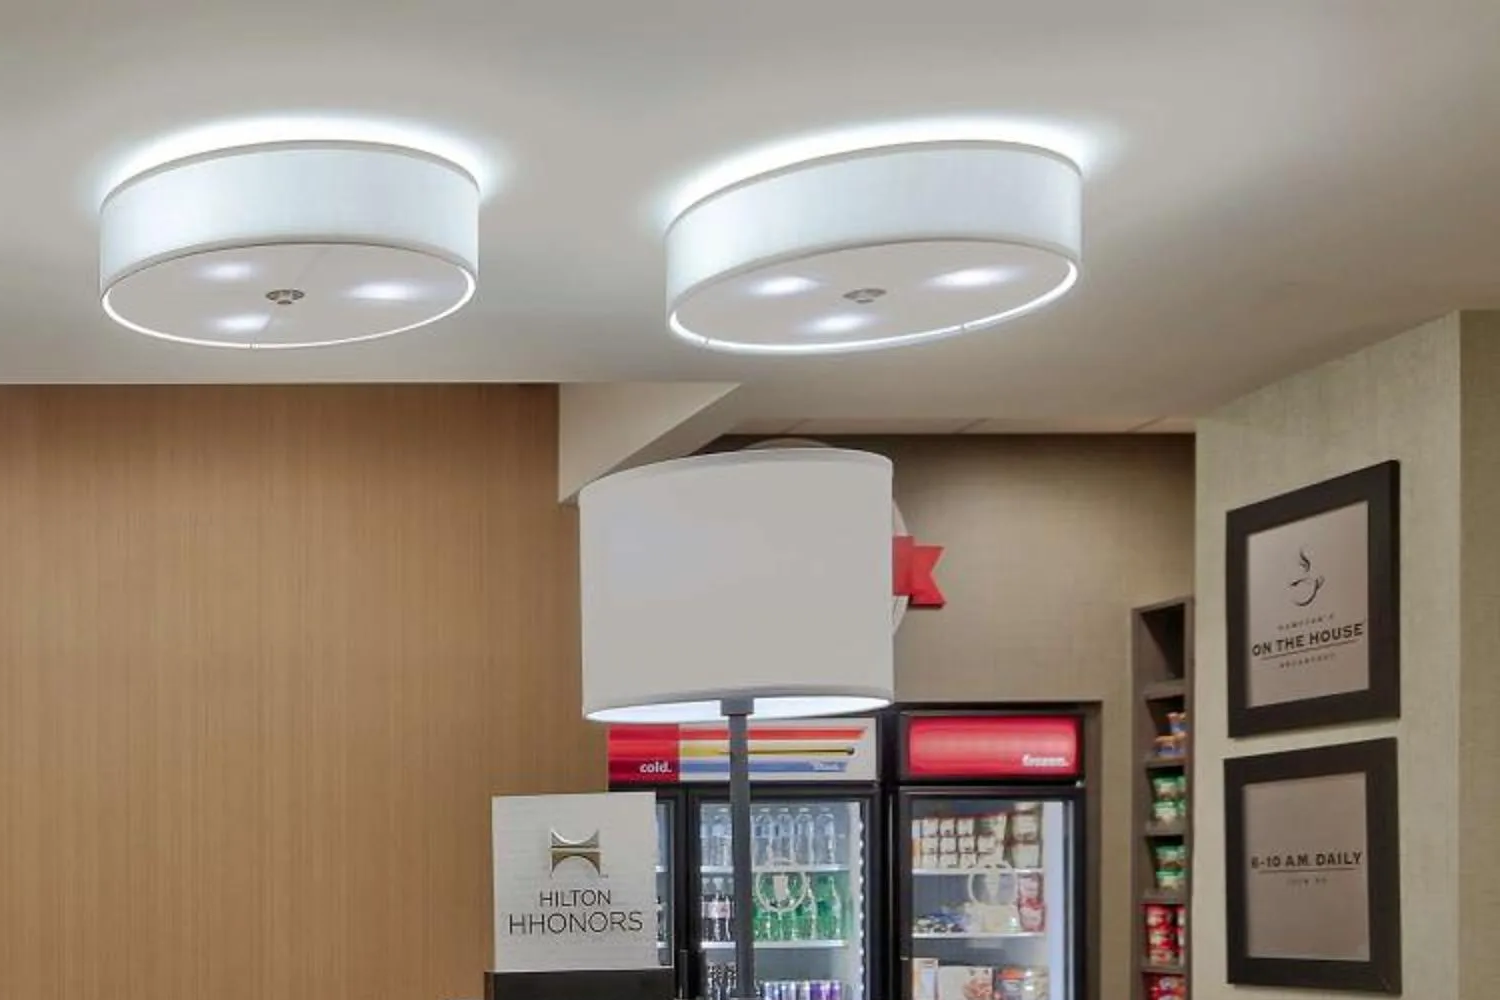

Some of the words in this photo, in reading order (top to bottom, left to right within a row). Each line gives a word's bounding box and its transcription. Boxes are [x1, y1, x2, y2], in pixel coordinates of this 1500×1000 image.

[1251, 643, 1272, 657] ON
[1276, 635, 1305, 652] THE
[1309, 623, 1364, 645] HOUSE
[1315, 851, 1362, 866] DAILY
[539, 889, 611, 907] HILTON
[509, 911, 644, 935] HHONORS
